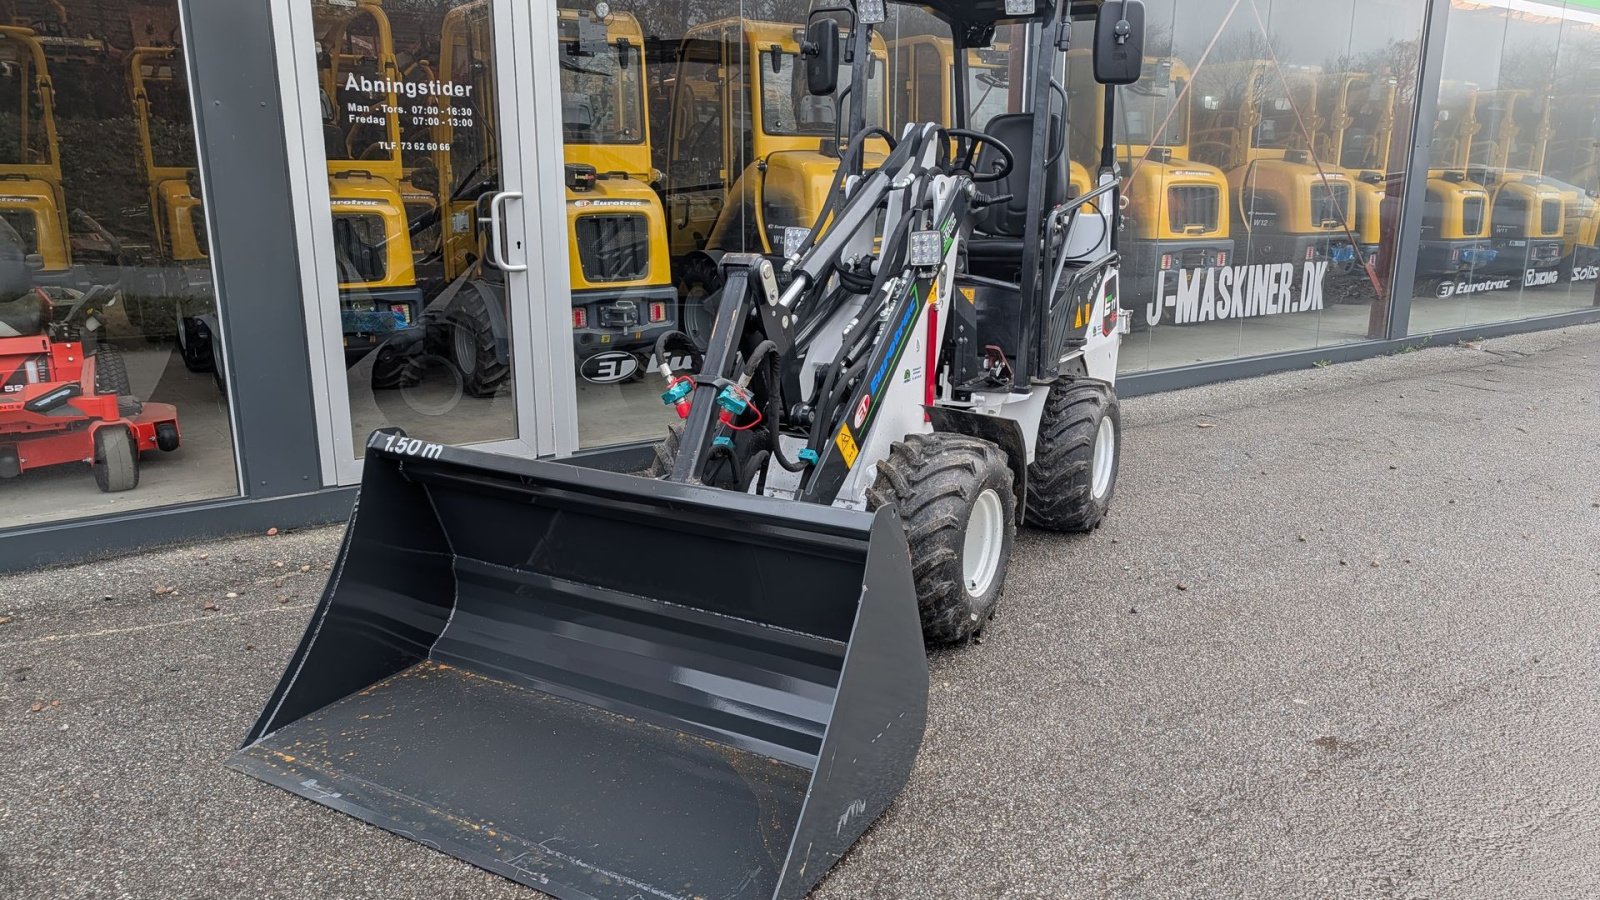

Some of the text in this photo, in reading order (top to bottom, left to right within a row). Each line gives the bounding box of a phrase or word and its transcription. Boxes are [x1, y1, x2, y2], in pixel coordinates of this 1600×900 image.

[345, 72, 472, 97] Åbningstider
[348, 103, 370, 113] Man
[381, 105, 407, 114] Tors.
[411, 106, 438, 115] 07:00
[446, 107, 472, 116] 16:30
[349, 115, 386, 125] Fredag
[412, 117, 439, 126] 07:00
[448, 117, 473, 127] 13:00
[378, 141, 450, 151] TLF. 73 62 60 66
[1146, 261, 1328, 326] J-MASKINER.DK
[1456, 280, 1511, 295] Eurotrac
[870, 297, 916, 396] Eurotrac
[4, 384, 24, 392] 52
[384, 435, 443, 459] 1.50 m
